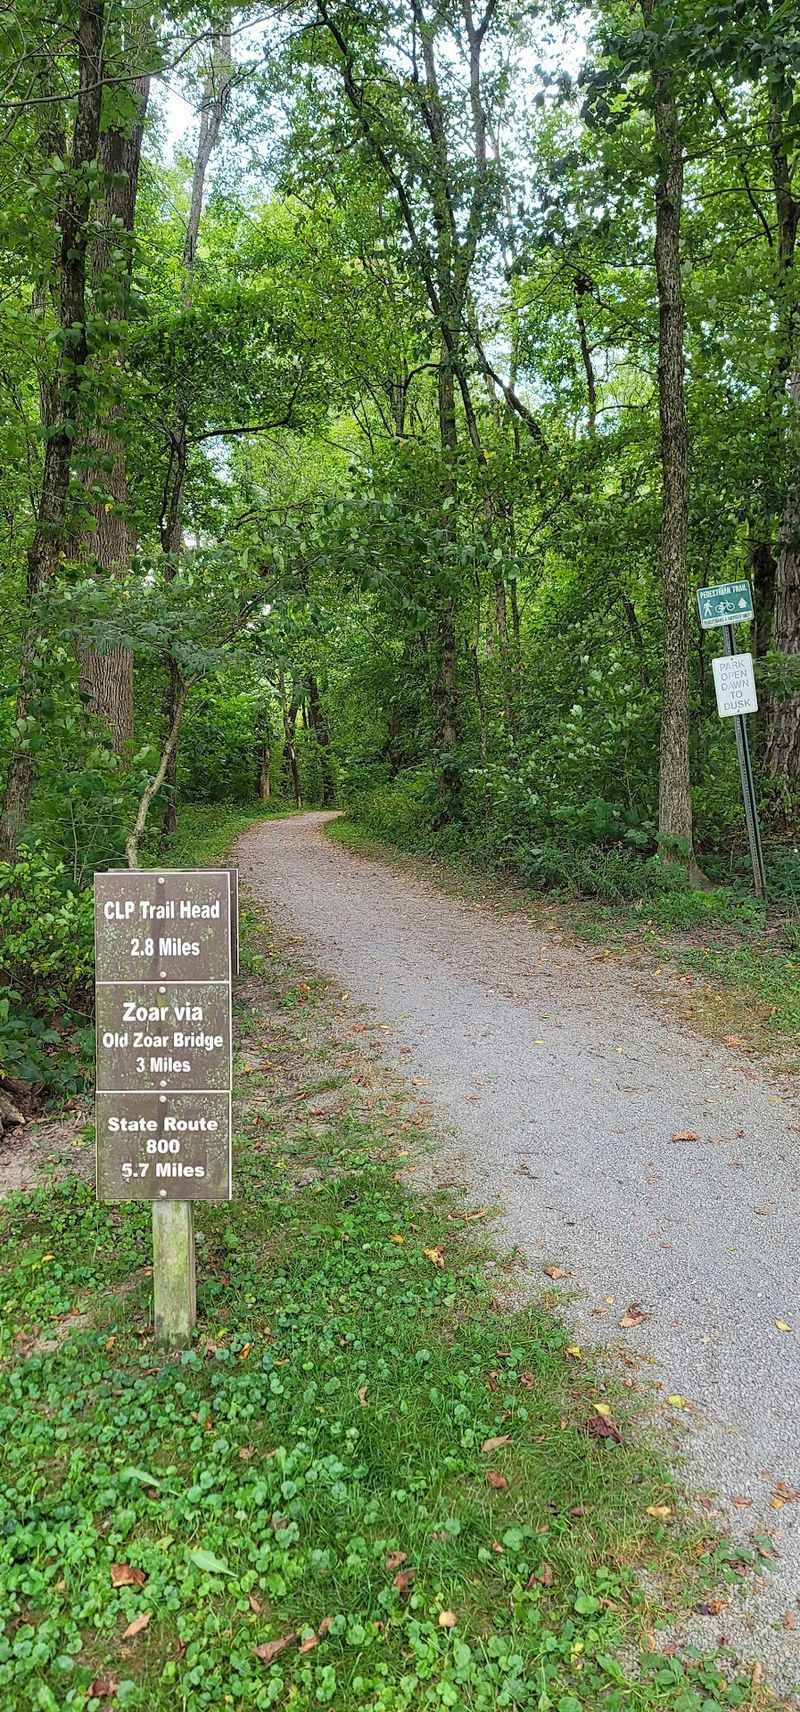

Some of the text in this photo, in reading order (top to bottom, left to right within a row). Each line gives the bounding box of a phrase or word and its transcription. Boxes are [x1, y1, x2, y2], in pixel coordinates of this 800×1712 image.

[731, 583, 748, 593] TRAIL
[720, 660, 745, 671] PARK
[721, 670, 747, 681] OPEN
[721, 680, 749, 691] DAWN
[730, 690, 743, 699] TO
[723, 698, 751, 710] DUSK
[104, 900, 220, 920] CLP Trail Head
[130, 937, 200, 957] 2.8 Miles
[122, 1002, 203, 1022] Zoar via
[102, 1032, 223, 1052] Old Zoar Bridge
[136, 1056, 191, 1073] 3 Miles
[107, 1116, 219, 1132] State Route
[146, 1139, 180, 1154] 800
[121, 1161, 205, 1179] 5.7 Miles
